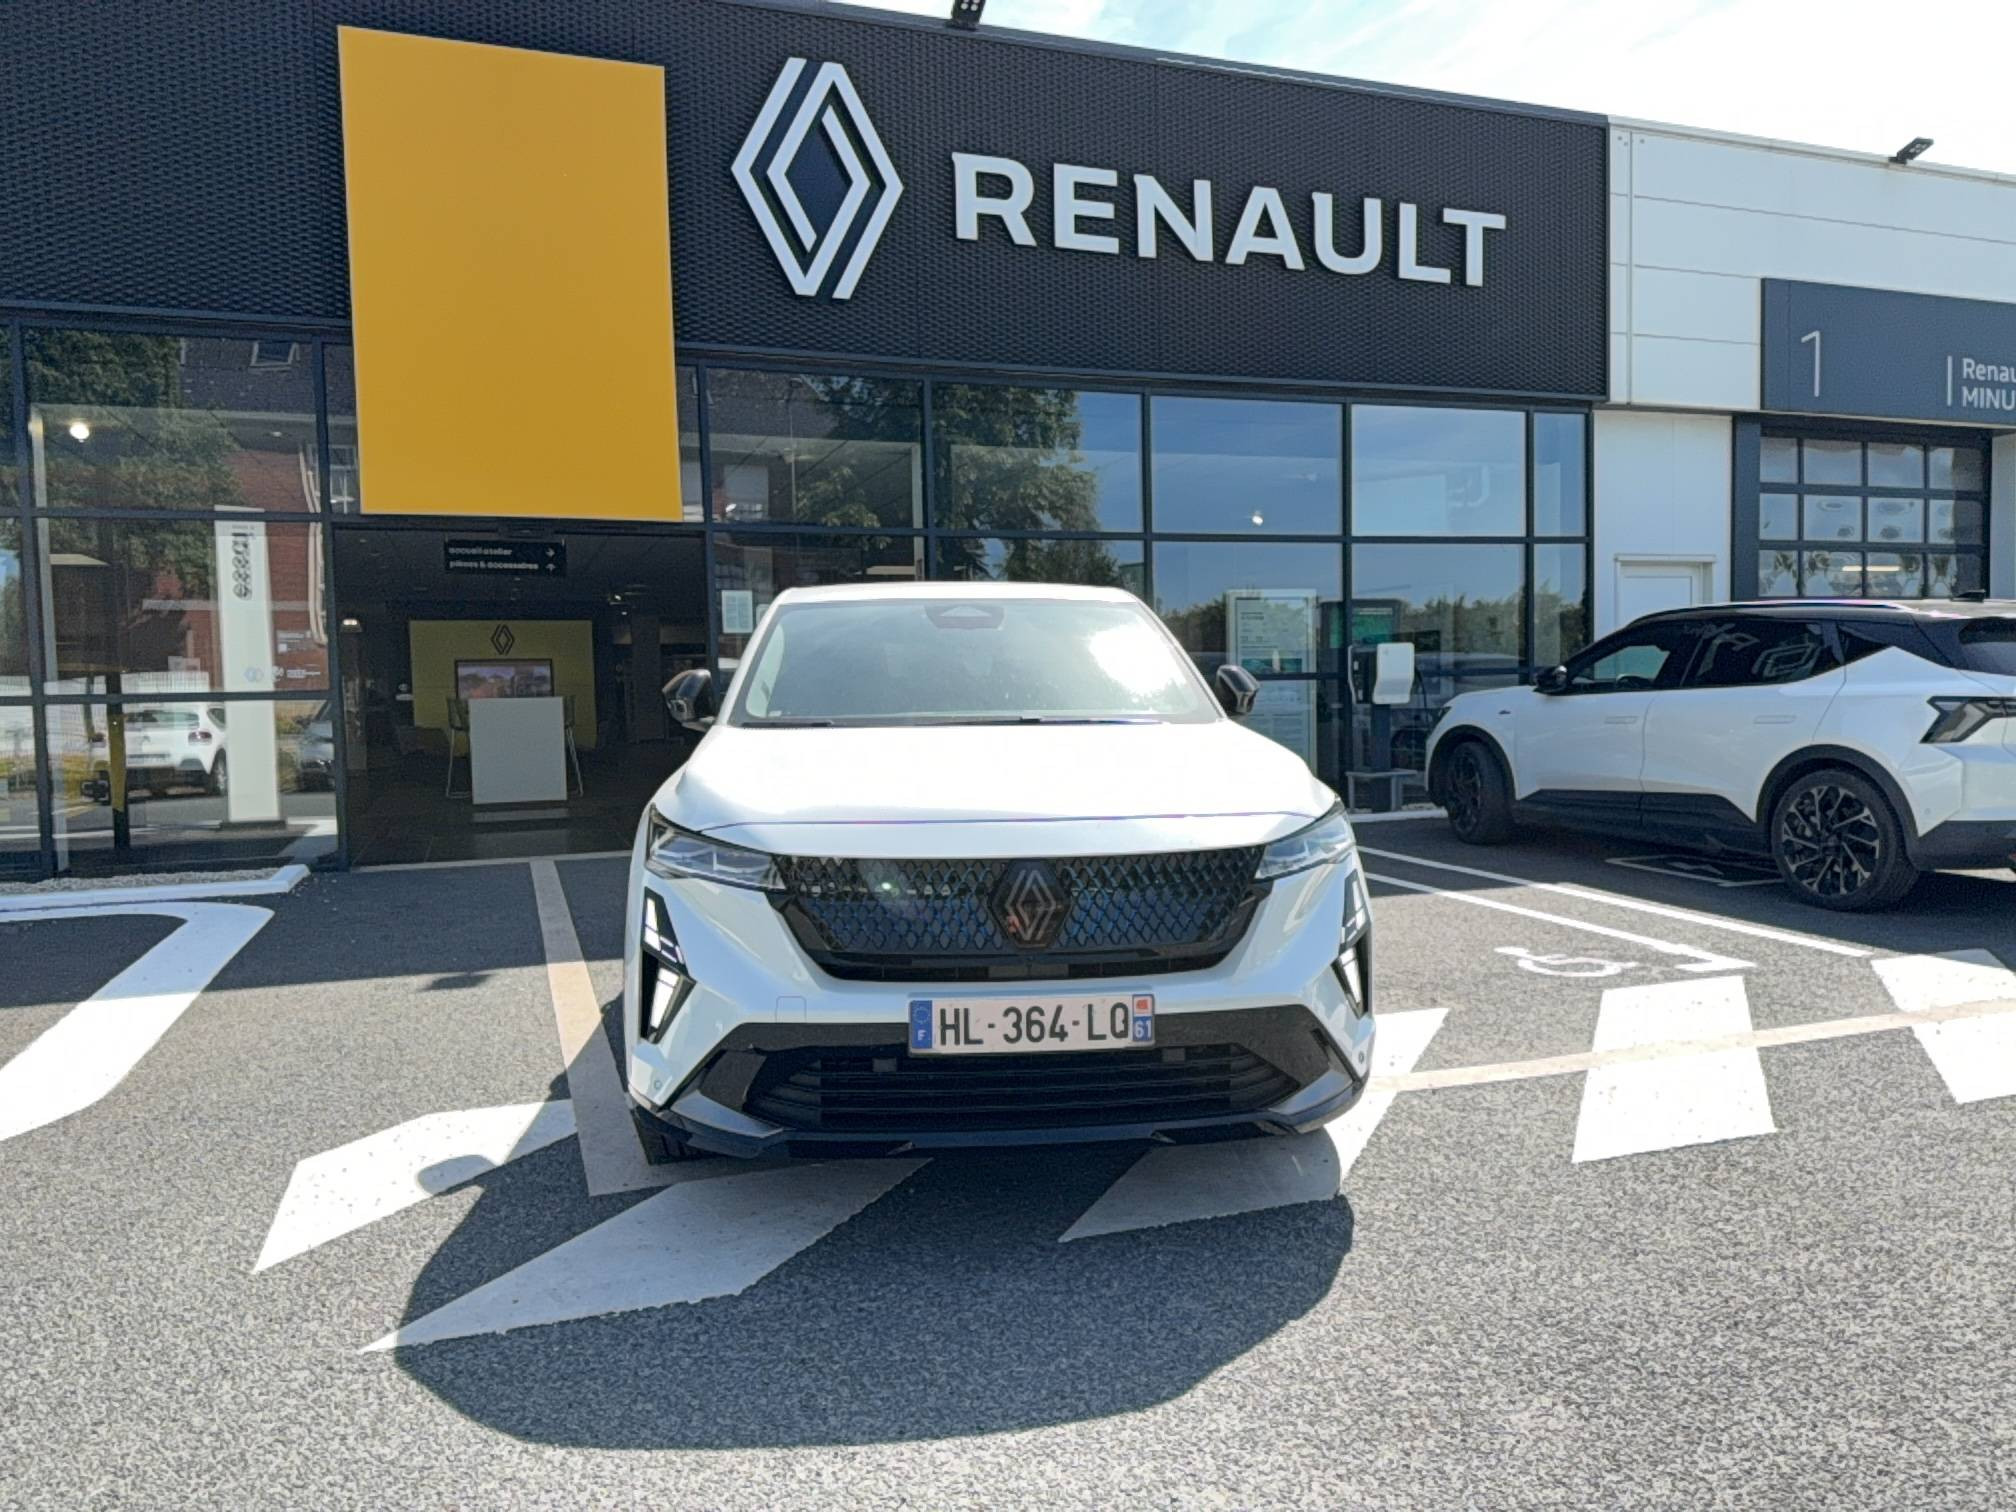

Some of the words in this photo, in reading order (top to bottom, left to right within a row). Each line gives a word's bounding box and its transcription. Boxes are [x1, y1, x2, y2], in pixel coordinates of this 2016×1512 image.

[951, 152, 1507, 287] RENAULT
[1801, 330, 1820, 397] 1
[1962, 386, 2016, 410] MINU
[917, 1030, 927, 1041] F
[1134, 1020, 1152, 1039] 61
